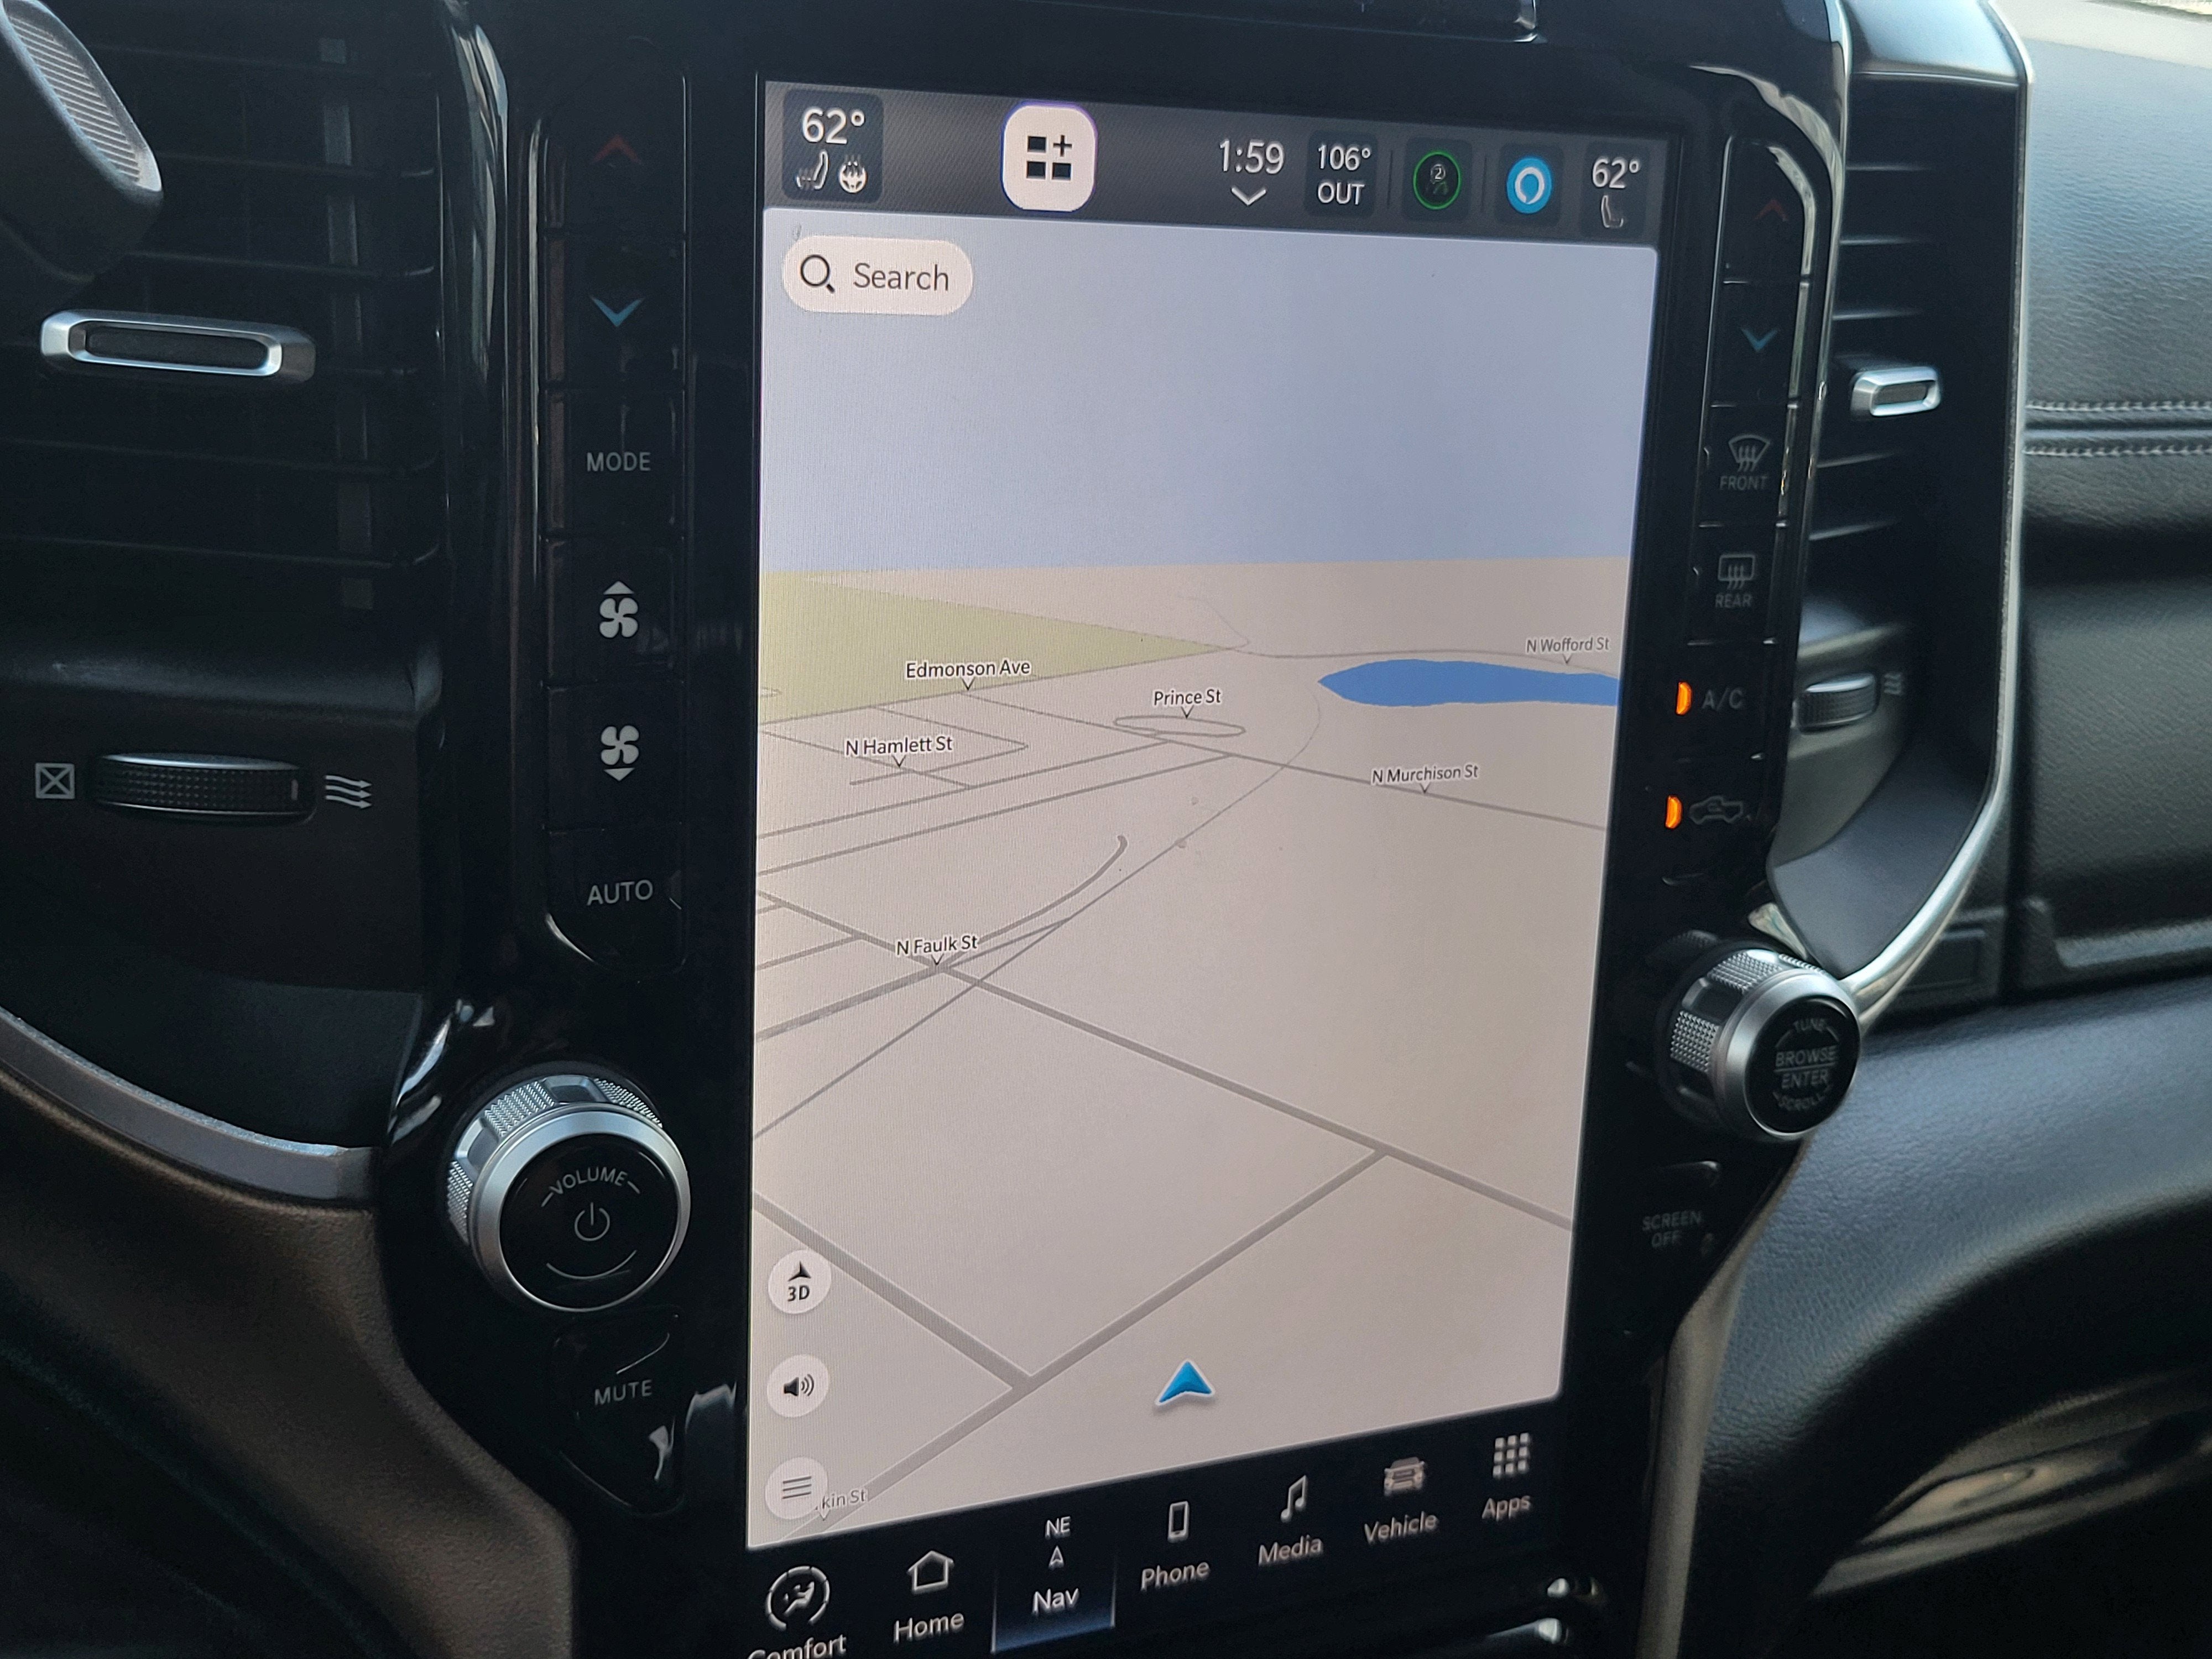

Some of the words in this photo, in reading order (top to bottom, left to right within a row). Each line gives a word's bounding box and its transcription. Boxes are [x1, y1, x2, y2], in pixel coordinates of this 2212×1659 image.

[801, 107, 865, 145] 62°
[1219, 139, 1285, 175] 1:59
[1317, 144, 1372, 171] 106°
[1592, 156, 1641, 190] 62°
[1317, 182, 1365, 206] OUT
[853, 262, 950, 291] Search
[586, 451, 652, 472] MODE
[1719, 474, 1767, 491] FRONT
[1715, 593, 1752, 609] REAR
[1526, 639, 1537, 653] N
[1540, 637, 1593, 653] Wofford
[1596, 637, 1610, 651] St
[906, 661, 995, 679] Edmonson
[999, 659, 1031, 676] Ave
[1154, 690, 1204, 706] Prince
[1206, 688, 1222, 704] St
[1702, 687, 1745, 711] A/C
[846, 740, 860, 756] N
[864, 738, 932, 755] Hamlett
[935, 736, 953, 753] St
[1372, 770, 1383, 784] N
[1387, 765, 1461, 782] Murchison
[1464, 764, 1479, 779] St
[587, 880, 654, 906] AUTO
[897, 940, 909, 956] N
[914, 936, 958, 954] Faulk
[961, 935, 978, 950] St
[1775, 1045, 1838, 1067] BROWSE
[1781, 1068, 1828, 1089] ENTER
[549, 1166, 628, 1196] VOLUME
[1642, 1209, 1702, 1232] SCREEN
[1652, 1230, 1682, 1248] OFF
[787, 1284, 811, 1302] 3D
[594, 1380, 653, 1406] MUTE
[815, 1493, 846, 1510] kin
[849, 1489, 865, 1504] St
[1481, 1493, 1531, 1520] Apps
[1045, 1516, 1071, 1537] NE
[1364, 1510, 1438, 1544] Vehicle
[1258, 1534, 1324, 1566] Media
[1140, 1559, 1211, 1591] Phone
[1032, 1587, 1079, 1614] Nav
[893, 1610, 965, 1644] Home
